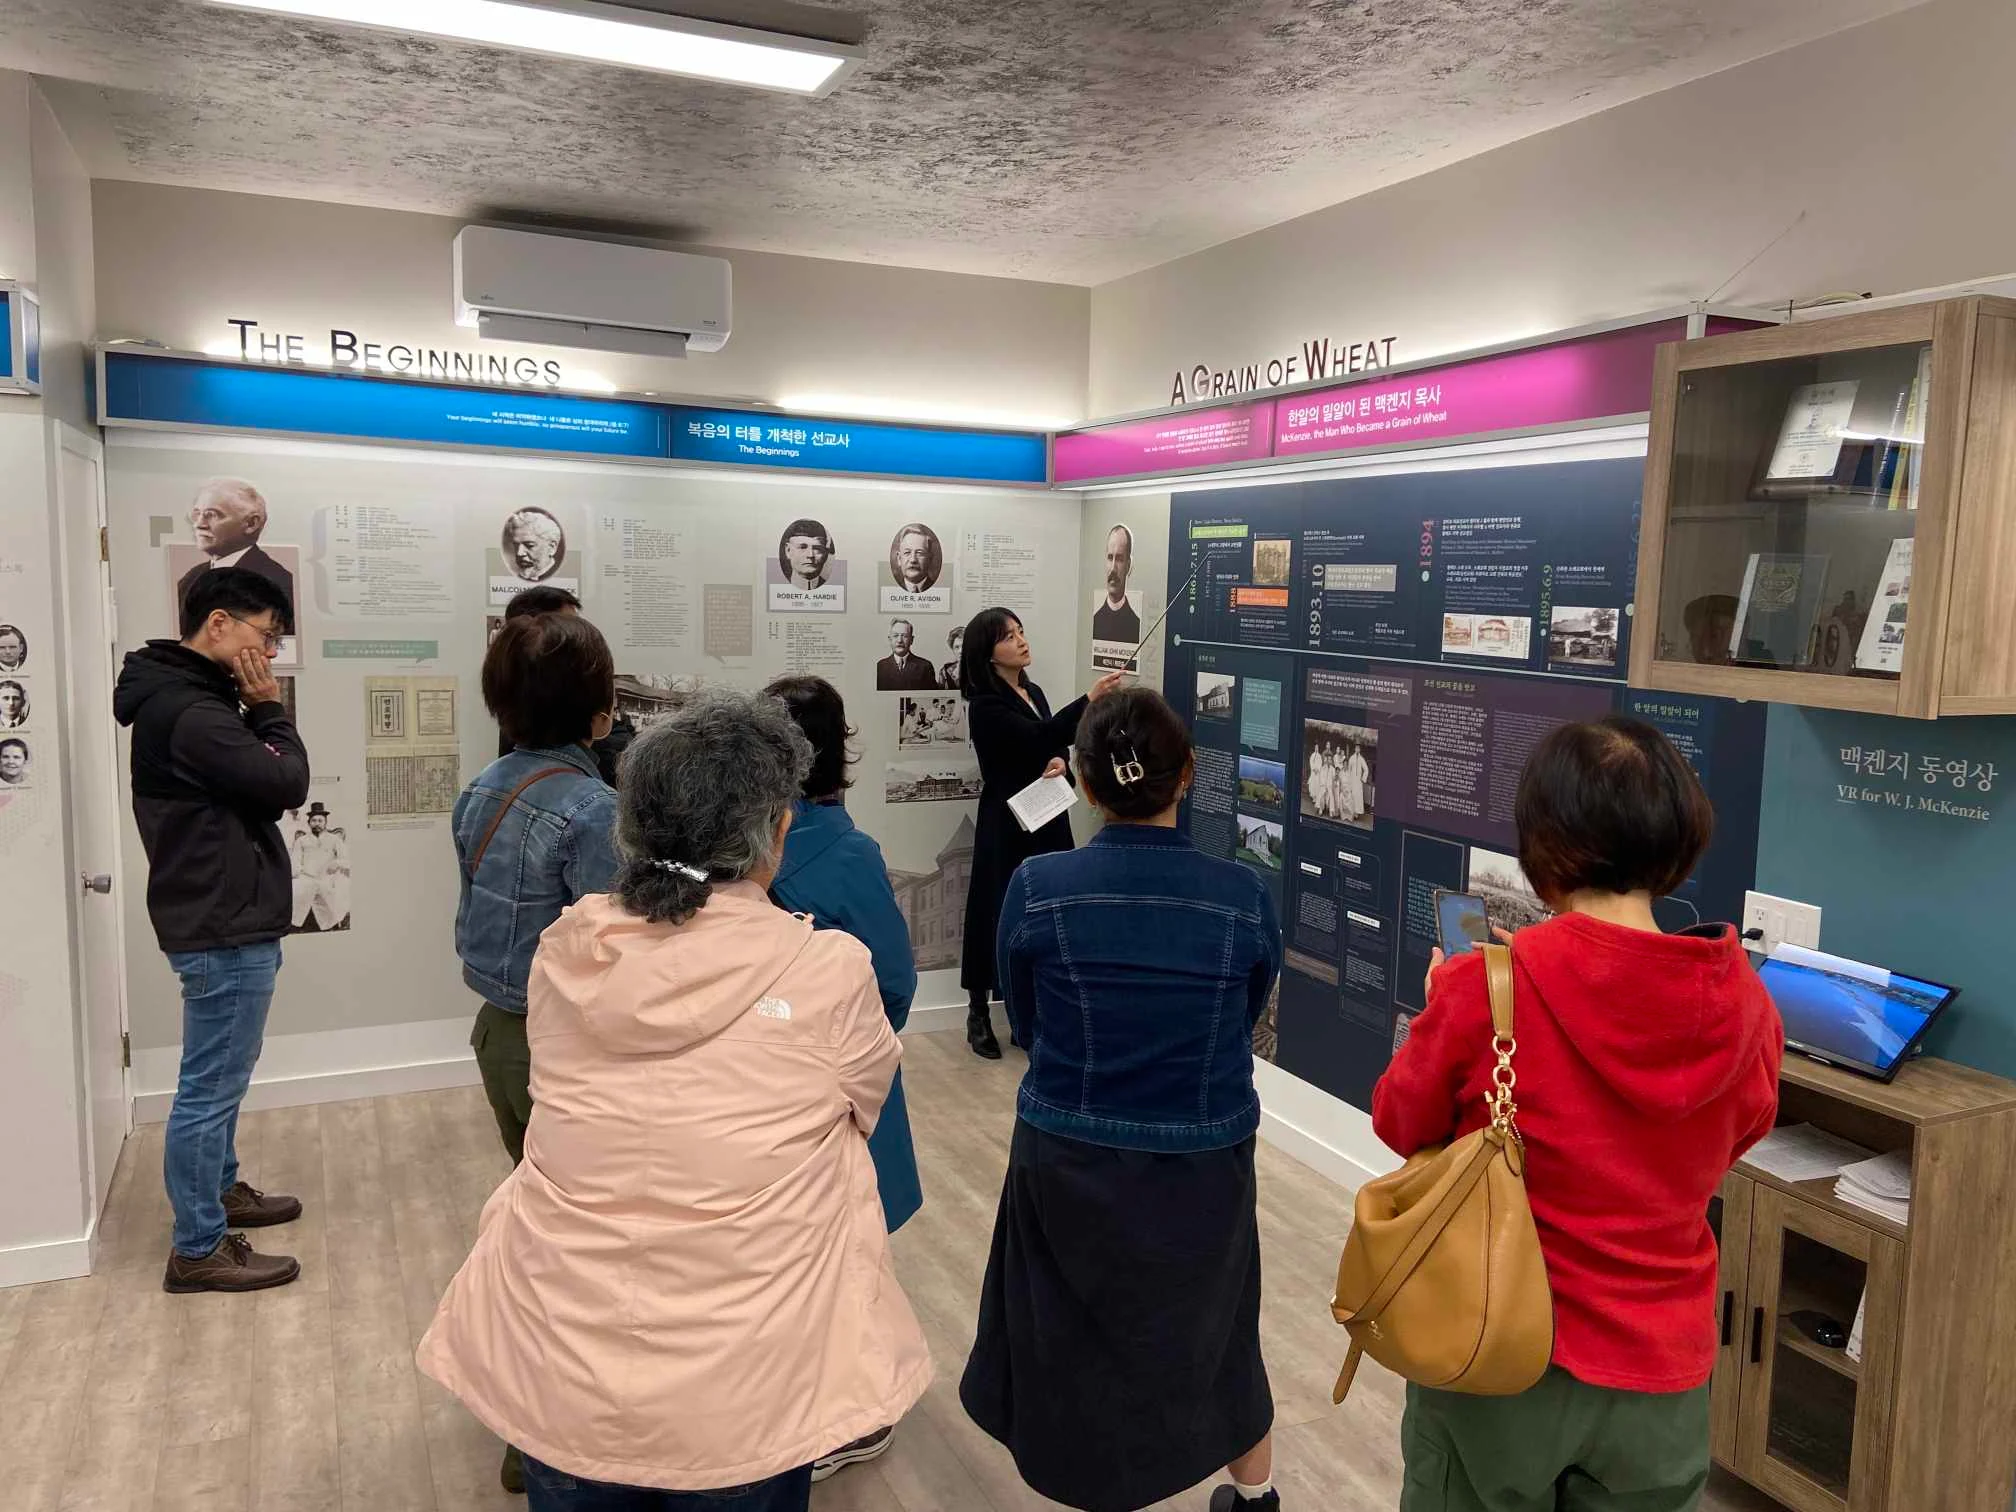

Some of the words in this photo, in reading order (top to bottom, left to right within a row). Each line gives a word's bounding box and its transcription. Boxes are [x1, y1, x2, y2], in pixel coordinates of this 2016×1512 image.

[228, 319, 304, 362] THE
[331, 329, 561, 386] BEGINNINGS
[1170, 371, 1187, 407] A
[1192, 364, 1259, 399] GRAIN
[1267, 357, 1297, 386] OF
[1303, 337, 1397, 380] WHEAT
[1288, 404, 1319, 428] 한알의
[1323, 399, 1356, 423] 밀알이
[1359, 396, 1371, 417] 된
[1375, 390, 1411, 414] 맥켄지
[1415, 384, 1442, 408] 목사
[1313, 429, 1325, 439] the
[1325, 427, 1340, 438] Man
[1341, 423, 1355, 435] Who
[1356, 420, 1385, 433] Became
[1391, 415, 1412, 428] Grain
[1413, 413, 1421, 425] of
[1422, 410, 1447, 424] Wheat
[688, 422, 731, 439] 복음의
[735, 426, 762, 442] 터를
[767, 428, 807, 445] 개척한
[811, 432, 850, 448] 선교사
[739, 445, 754, 454] The
[755, 445, 800, 458] Beginnings
[1309, 563, 1325, 648] 1893.10
[1539, 564, 1553, 625] 1895.6.9
[1839, 745, 1910, 781] 맥켄지
[1917, 755, 2000, 792] 동영상
[1837, 783, 1858, 800] VR
[1861, 788, 1881, 803] for
[1885, 791, 1902, 808] W.
[1904, 794, 1915, 810] J.
[1918, 796, 1991, 821] McKenzie
